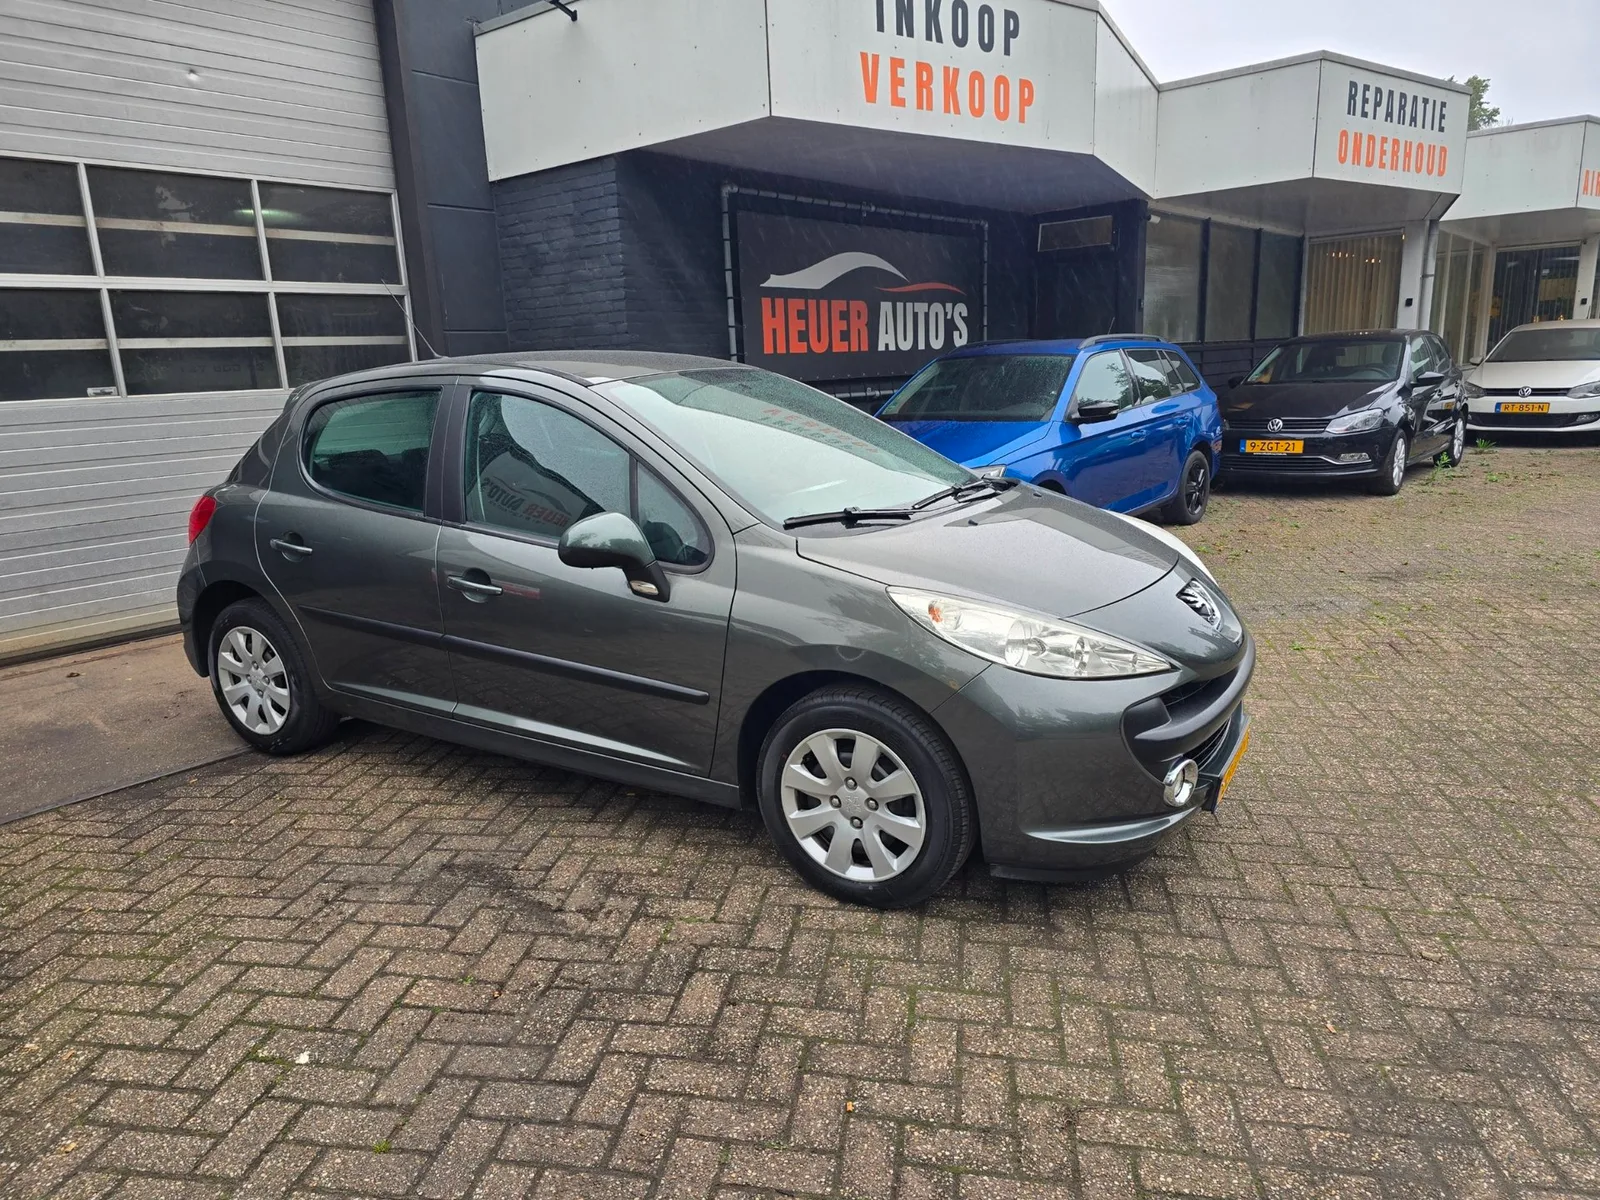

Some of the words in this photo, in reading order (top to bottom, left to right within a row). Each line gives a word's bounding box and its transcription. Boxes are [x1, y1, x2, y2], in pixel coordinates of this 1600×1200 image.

[875, 0, 1020, 56] INKOOP
[860, 51, 1035, 124] VERKOOP
[1347, 81, 1447, 132] REPARATIE
[1338, 129, 1448, 177] ONDERHOUD
[761, 297, 869, 354] HEUER
[877, 301, 968, 352] AUTO'S
[1503, 404, 1545, 412] RT-851-N
[1249, 441, 1296, 452] 9-ZGT-21
